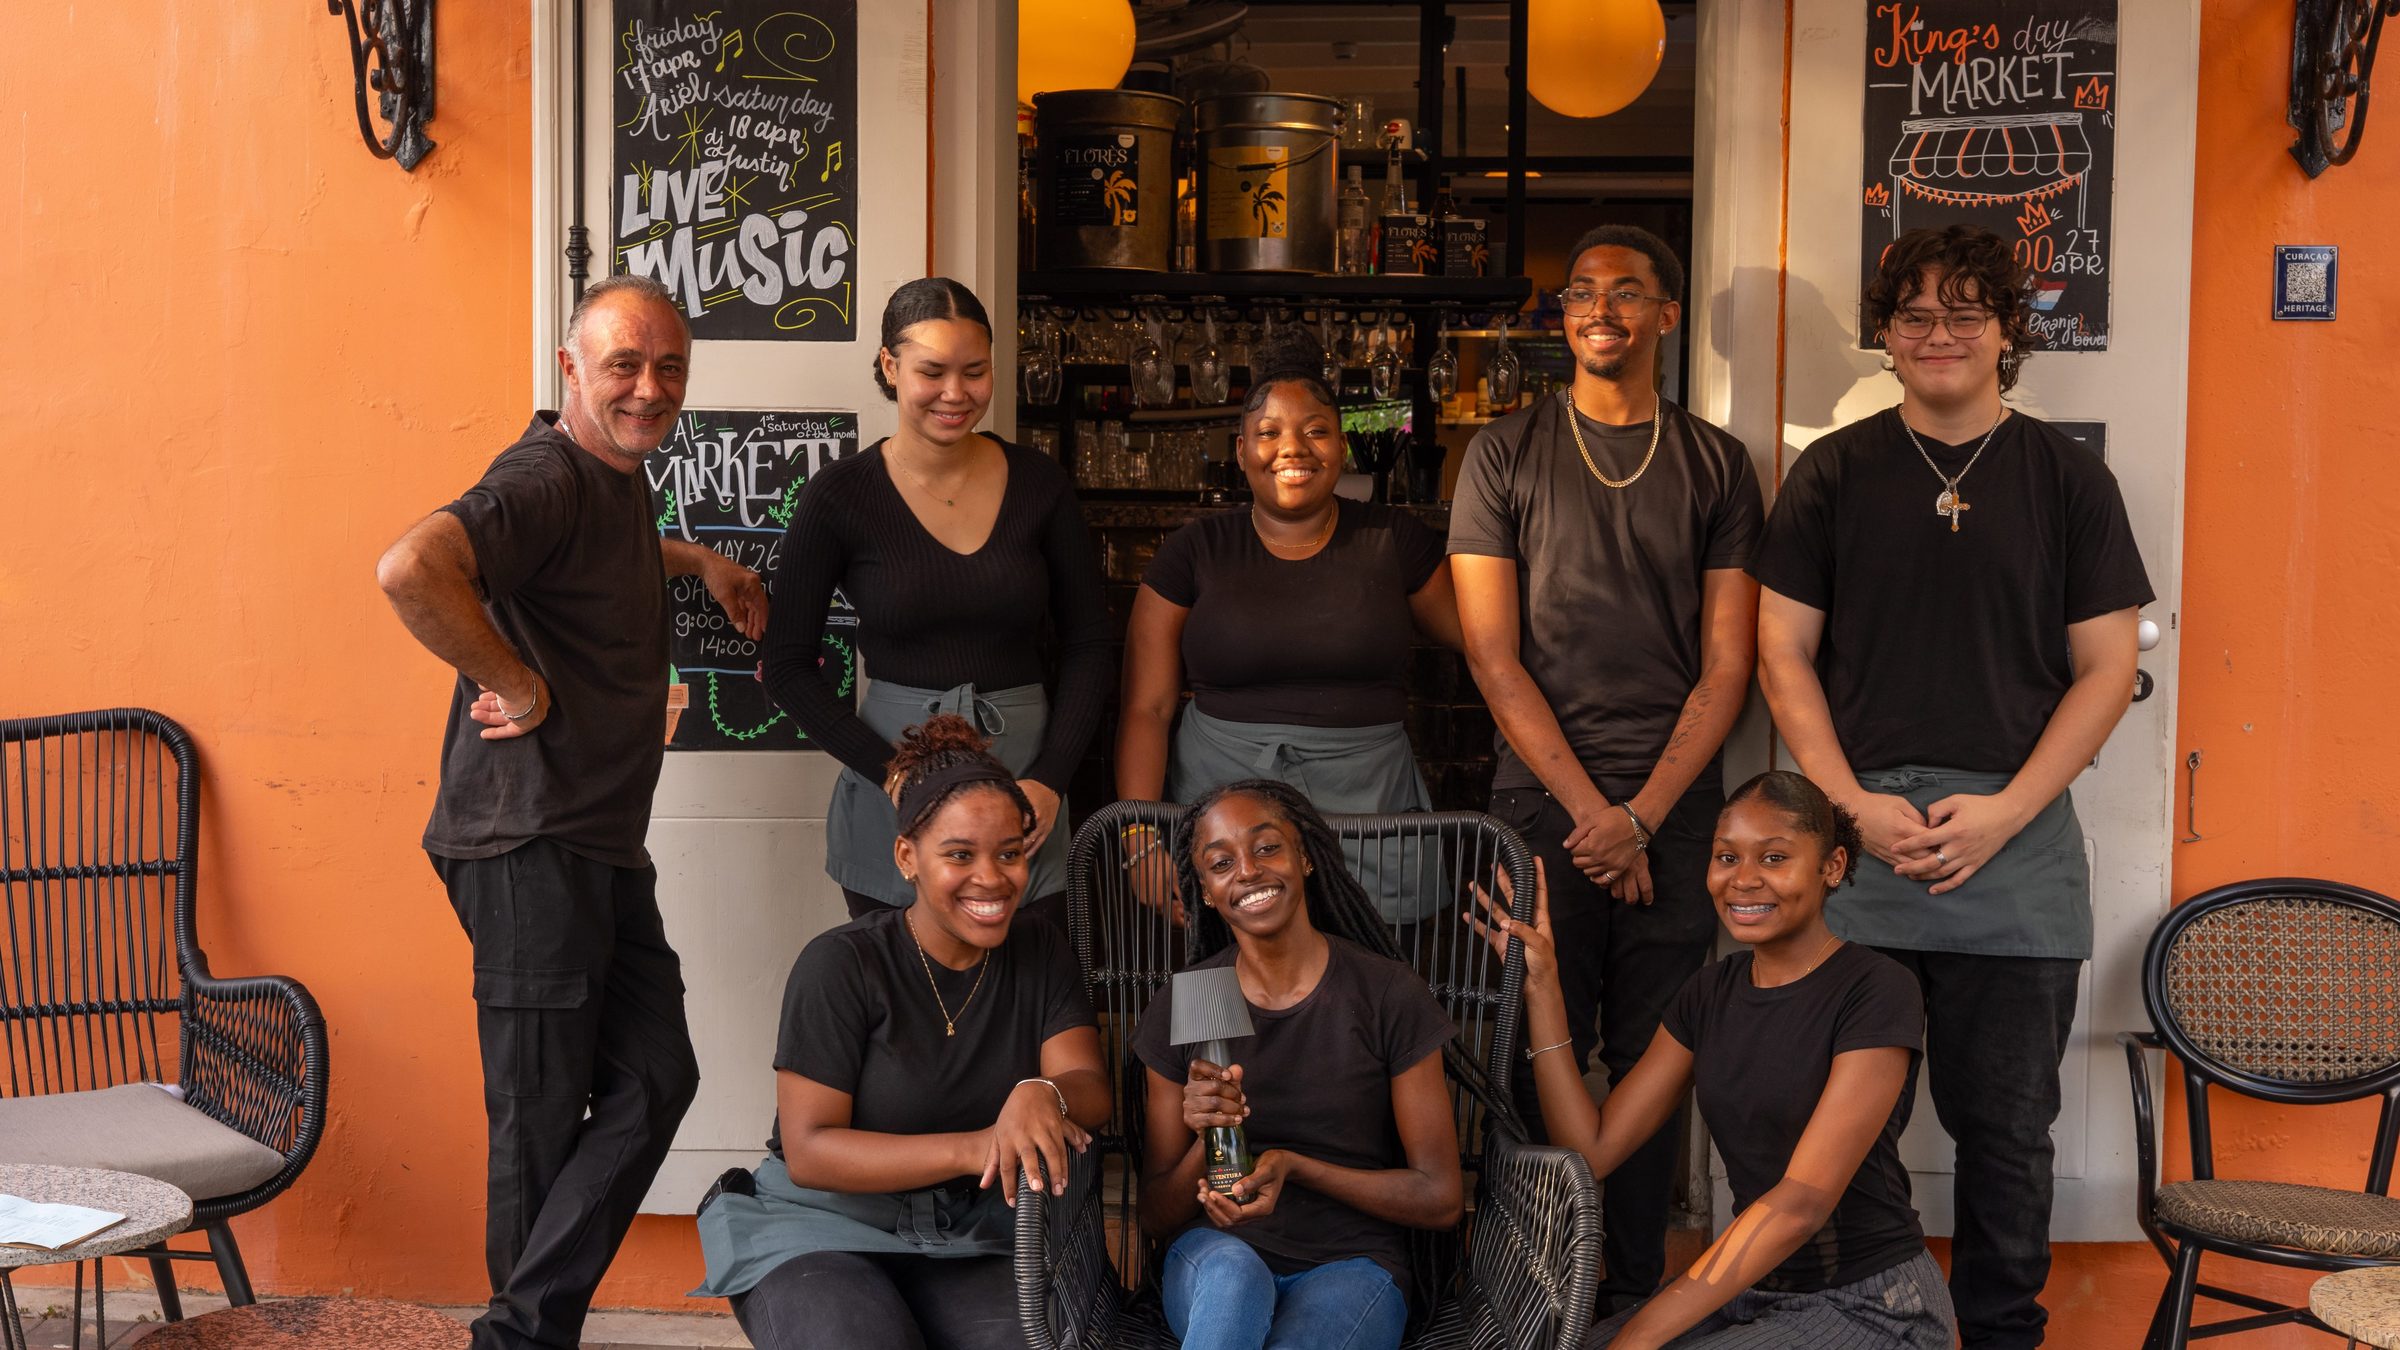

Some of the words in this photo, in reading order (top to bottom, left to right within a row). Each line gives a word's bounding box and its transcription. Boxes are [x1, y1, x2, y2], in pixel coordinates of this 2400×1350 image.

[629, 16, 723, 64] friday
[1874, 3, 2000, 68] King's
[2013, 15, 2077, 55] day
[623, 59, 651, 94] 17
[1909, 52, 2074, 115] MARKET
[713, 84, 835, 133] saturday
[704, 127, 724, 147] dj
[729, 115, 752, 139] 18
[704, 144, 790, 192] Justin
[620, 160, 726, 238] LIVE
[2065, 229, 2100, 256] 27
[2285, 253, 2329, 261] CURAÇAO
[2284, 304, 2327, 312] HERITAGE
[760, 414, 775, 427] 1st
[833, 430, 857, 439] month
[700, 635, 756, 657] 14:00
